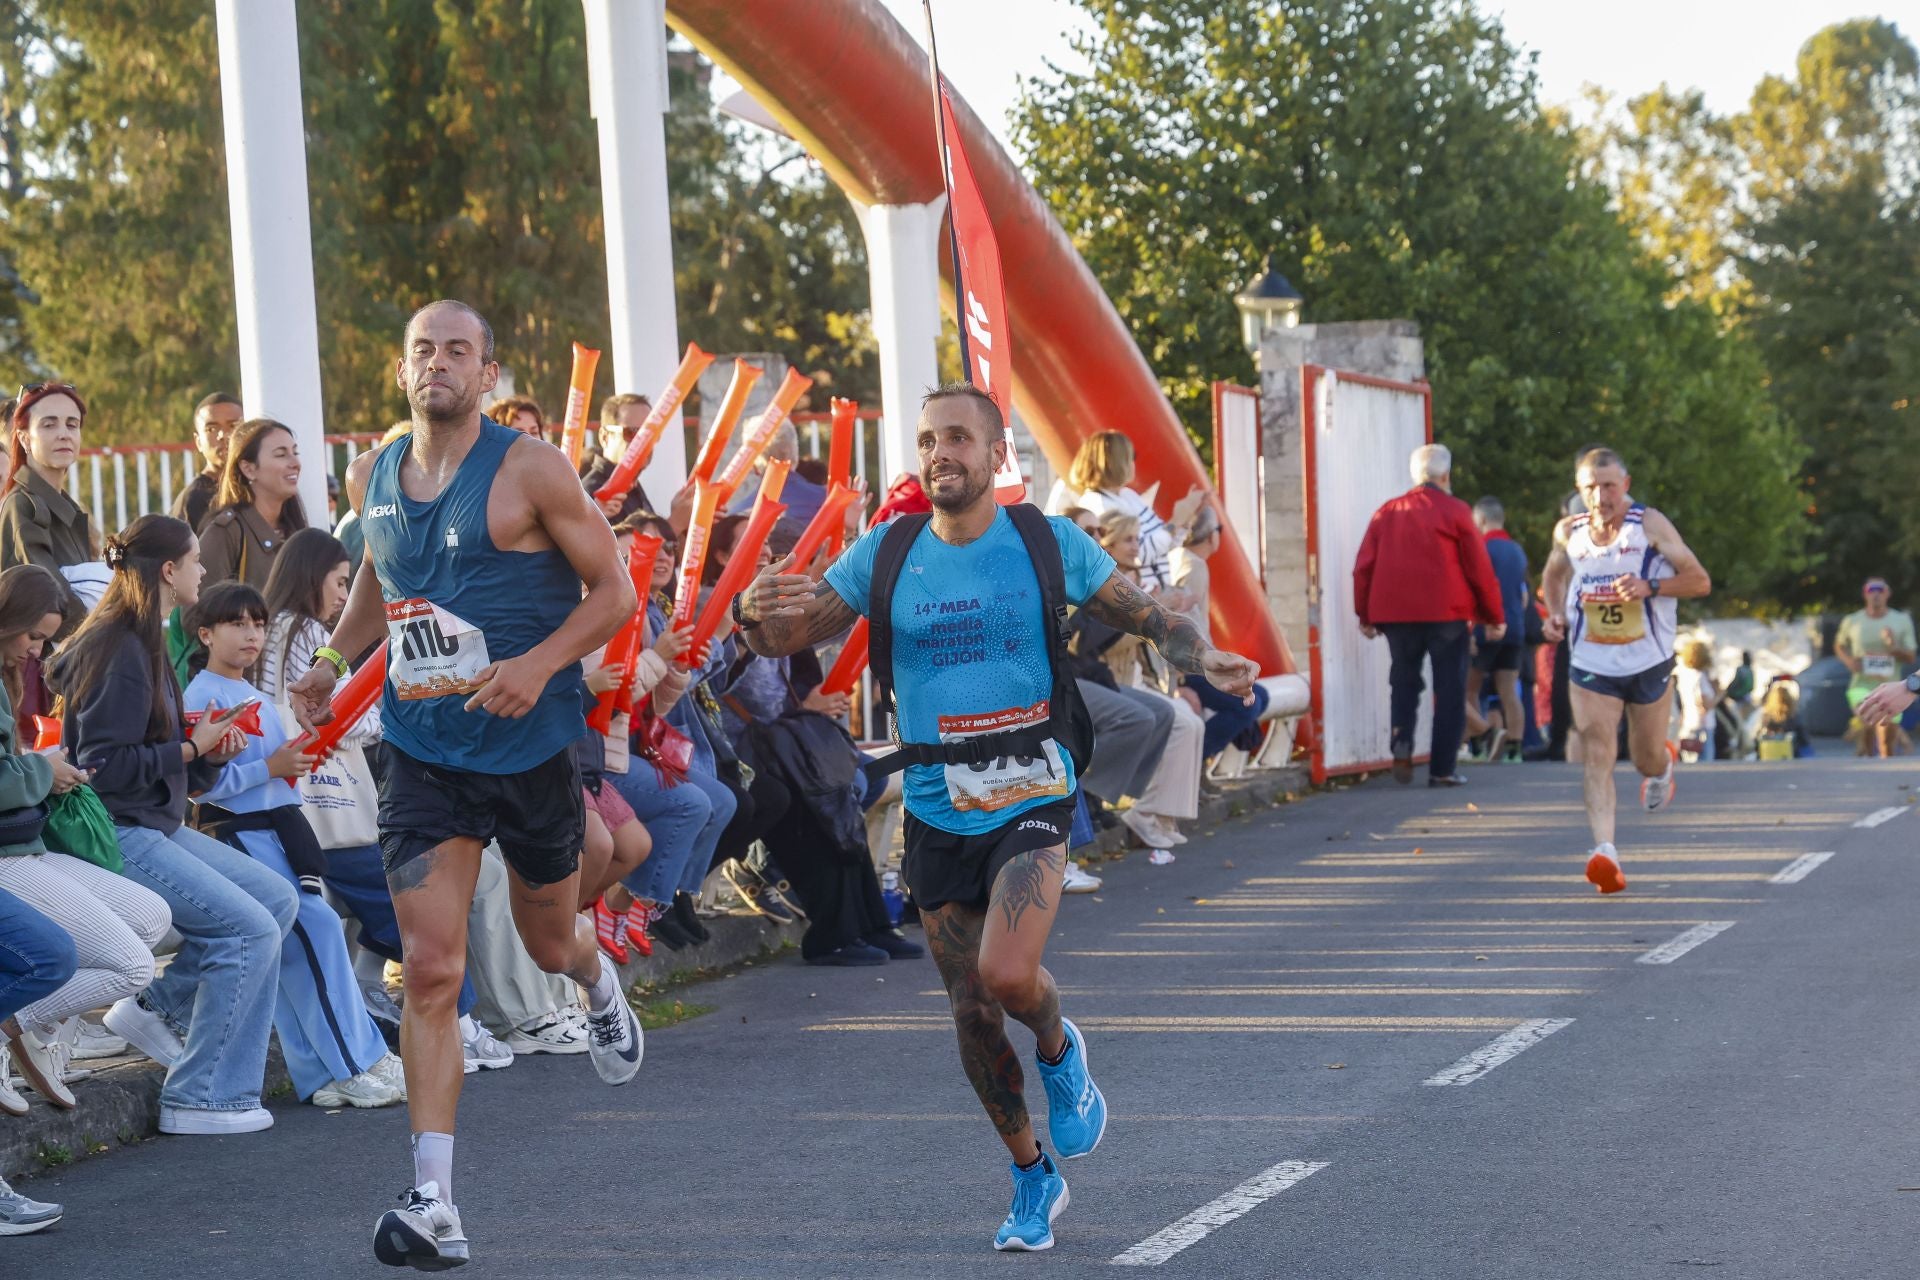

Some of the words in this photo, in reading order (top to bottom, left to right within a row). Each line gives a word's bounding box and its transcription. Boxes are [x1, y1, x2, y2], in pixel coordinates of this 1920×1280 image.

[368, 503, 397, 520] HOKA
[940, 598, 981, 614] MBA
[1598, 604, 1624, 625] 25
[931, 617, 983, 634] media
[916, 634, 985, 649] maraton
[973, 717, 997, 727] MBA
